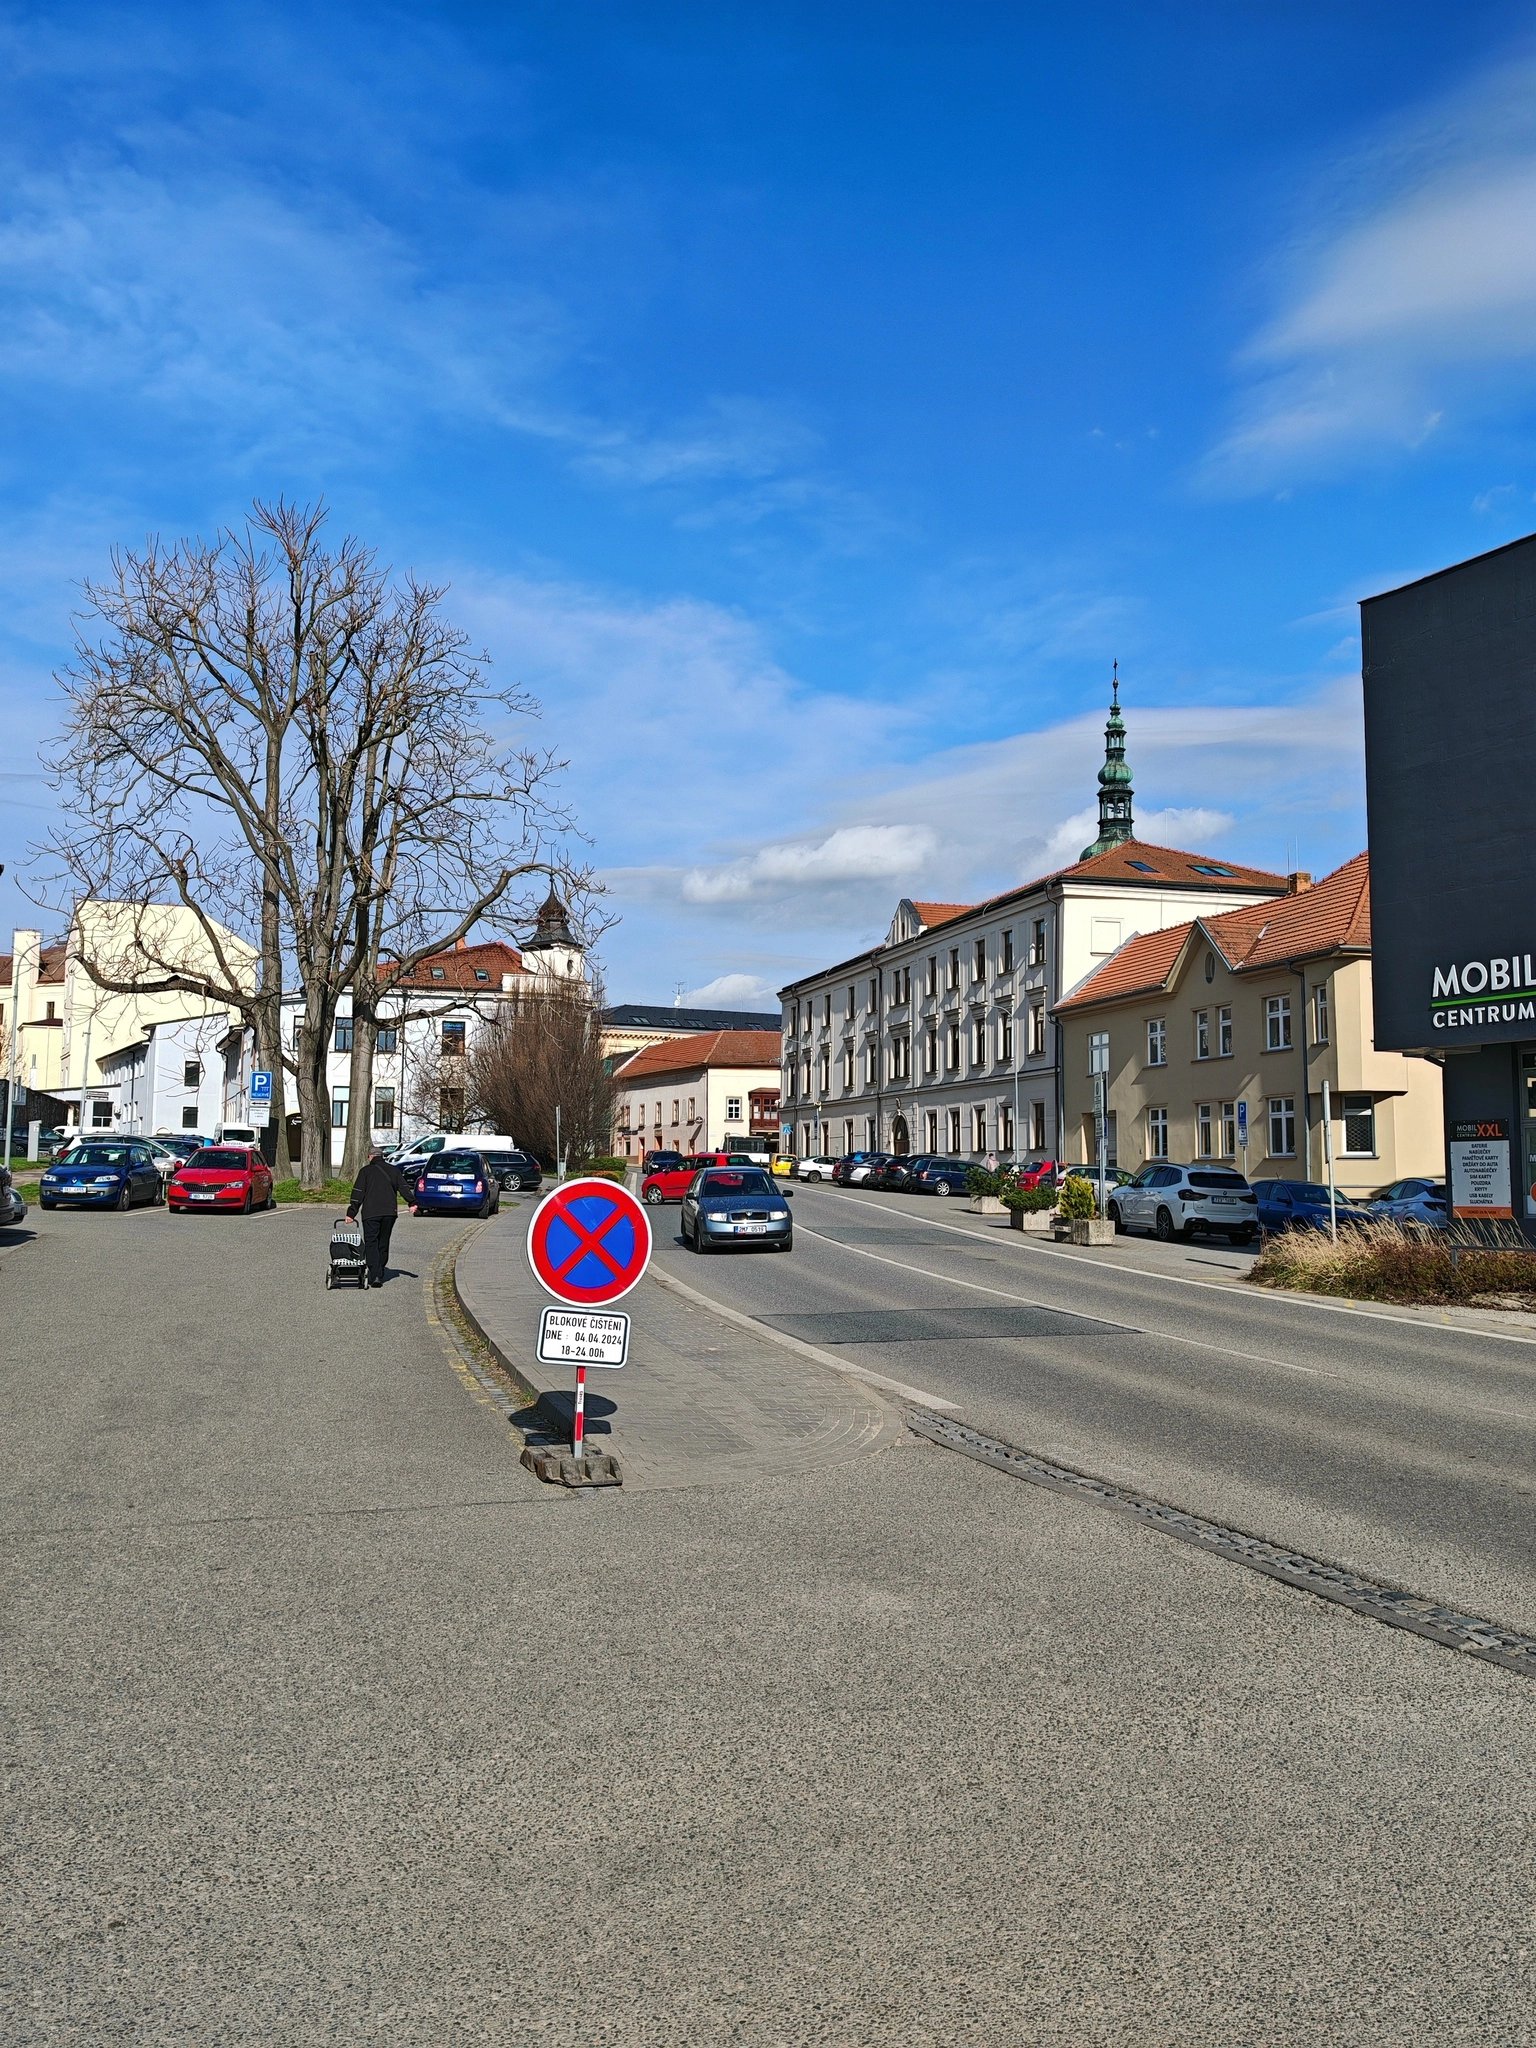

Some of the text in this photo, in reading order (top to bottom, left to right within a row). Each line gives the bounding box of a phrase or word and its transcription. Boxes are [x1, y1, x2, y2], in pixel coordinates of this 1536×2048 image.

[1432, 954, 1536, 998] MOBIL
[1432, 1001, 1535, 1028] CENTRUM
[254, 1075, 267, 1091] P
[1456, 1123, 1503, 1137] MOBIL XXL
[549, 1315, 622, 1331] BLOKOVÉ ČIŠTĚNÍ
[545, 1330, 563, 1340] DNE
[575, 1332, 622, 1345] 04.04.2024
